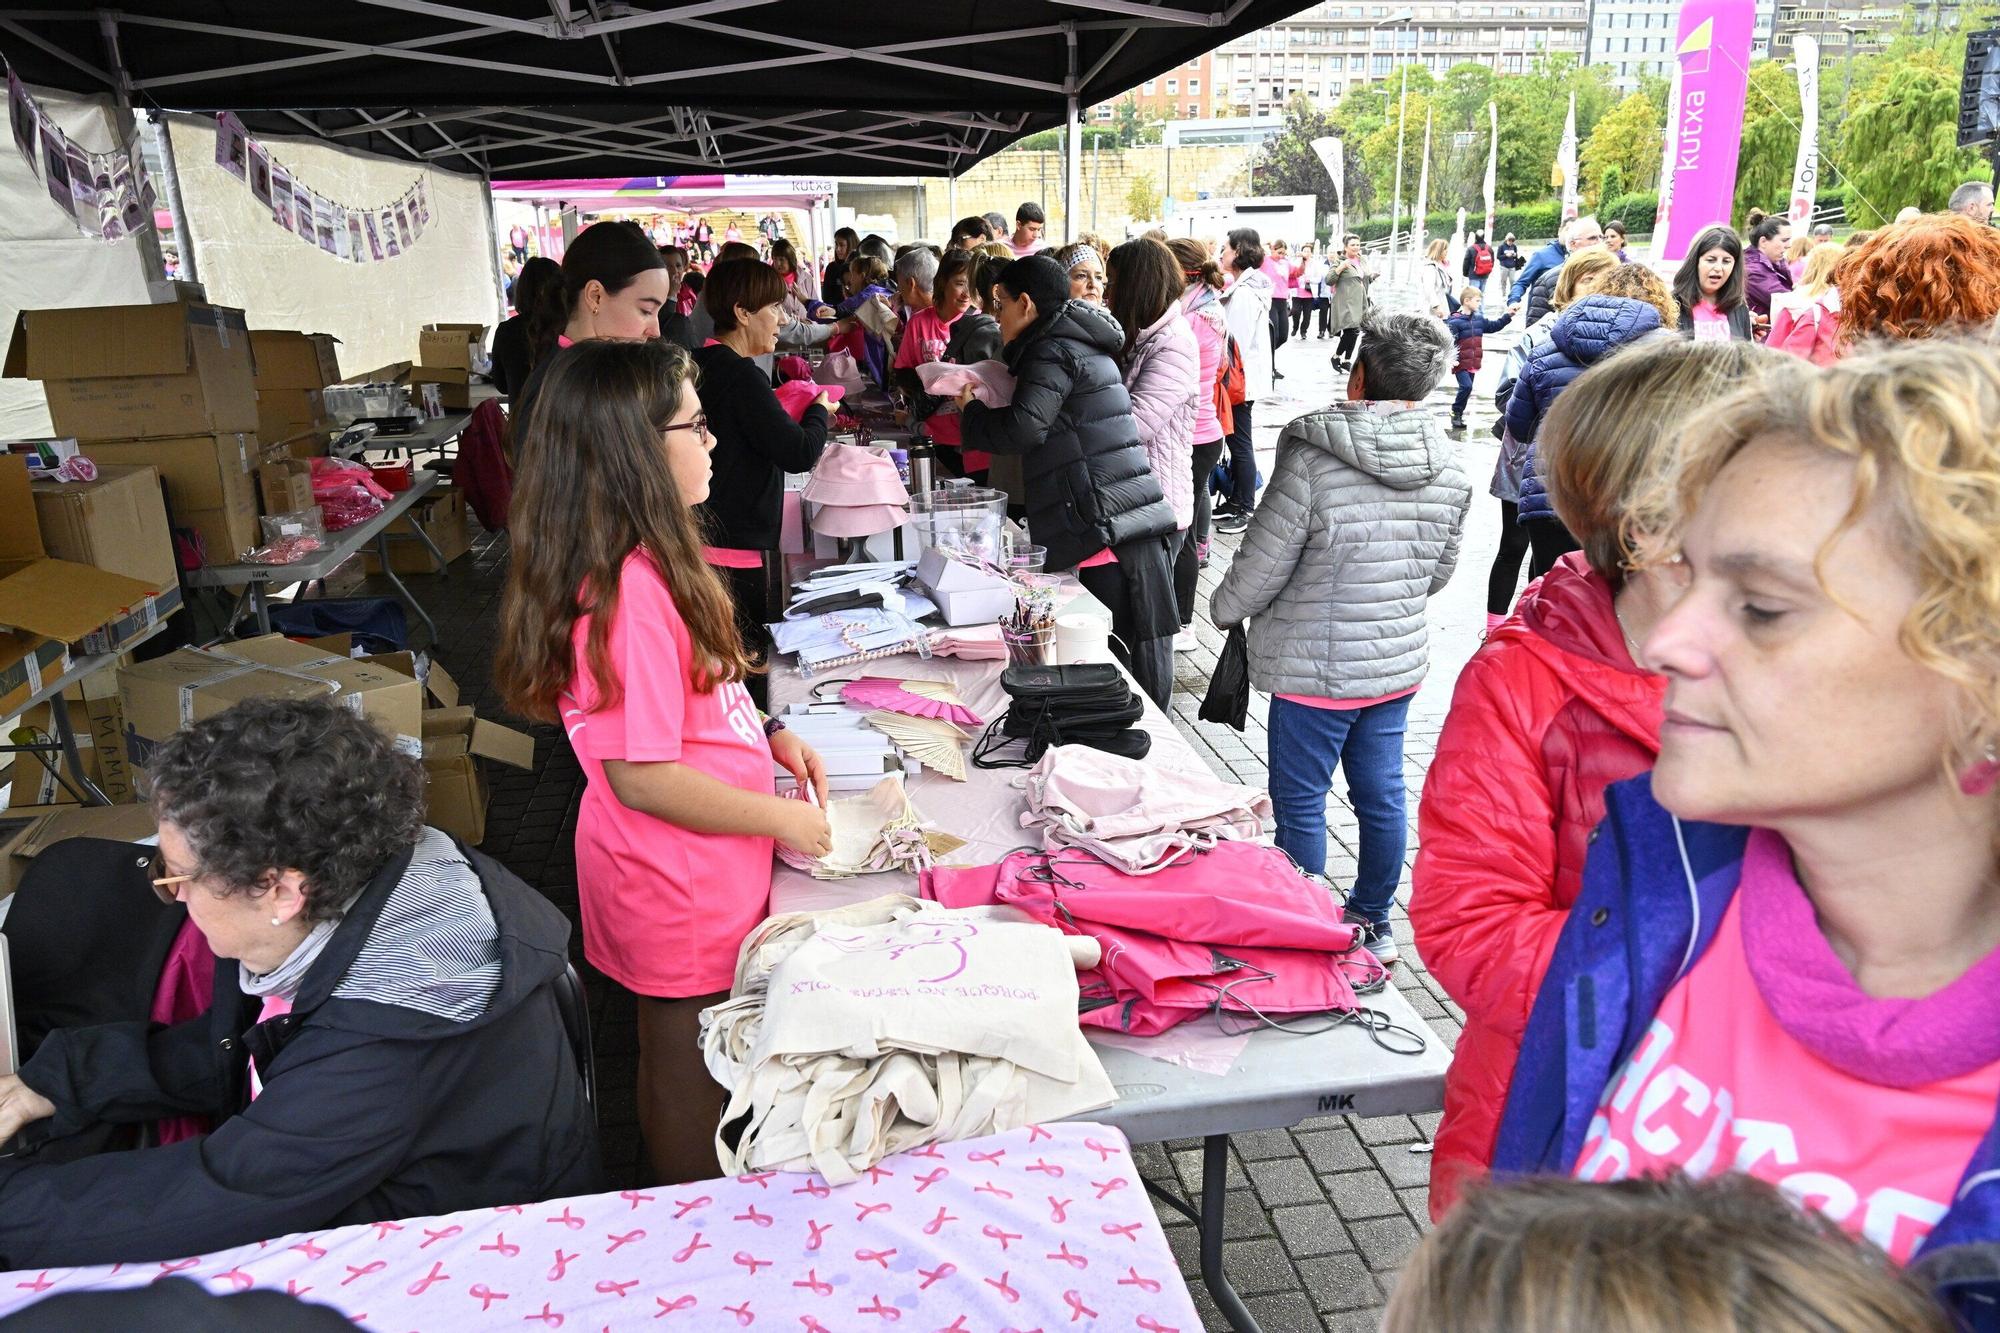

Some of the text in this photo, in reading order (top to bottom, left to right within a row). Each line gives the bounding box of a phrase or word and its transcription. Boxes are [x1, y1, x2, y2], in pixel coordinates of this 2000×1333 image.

[1677, 90, 1706, 170] kutxa
[792, 180, 832, 191] kutxa
[92, 715, 128, 796] MAMA
[1318, 1094, 1356, 1112] MK
